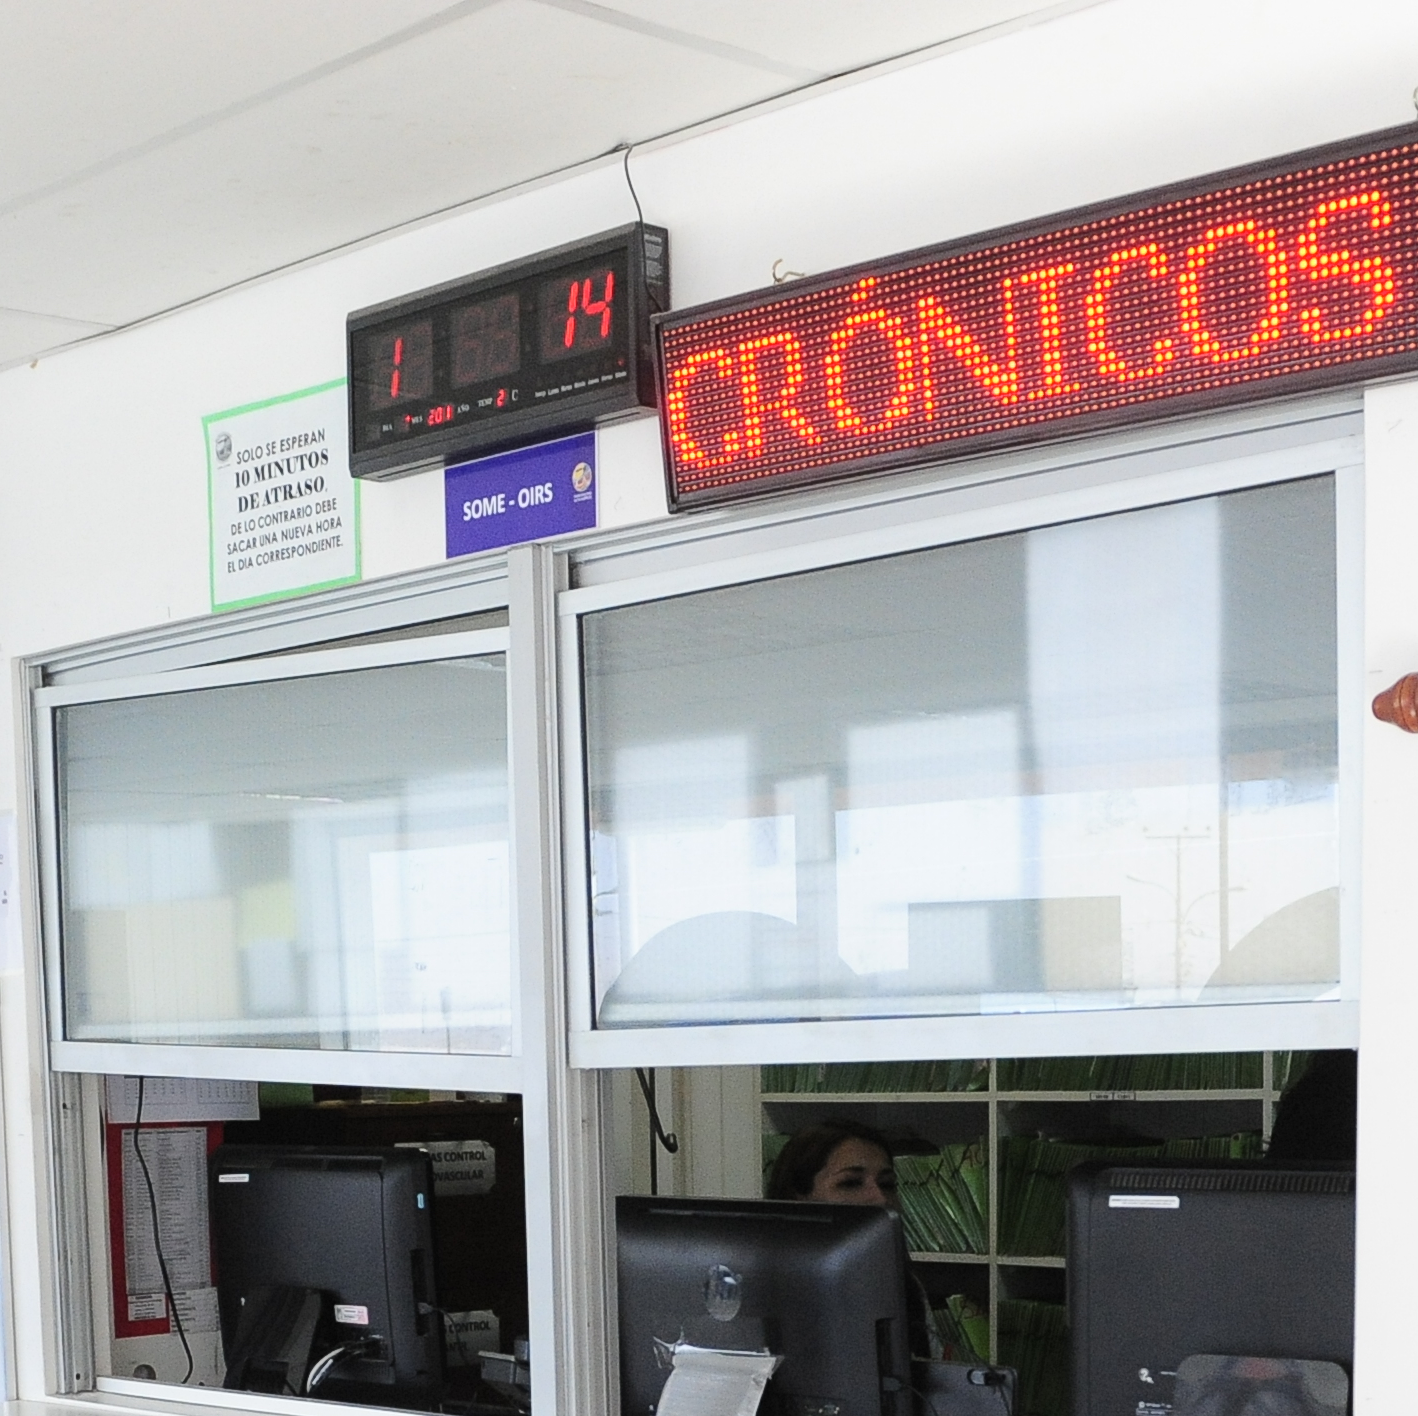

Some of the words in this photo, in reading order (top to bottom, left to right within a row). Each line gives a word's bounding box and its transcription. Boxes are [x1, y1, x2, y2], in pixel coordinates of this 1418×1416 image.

[564, 270, 615, 349] 14
[665, 189, 1396, 470] CRÓNICOS
[390, 337, 403, 399] 1
[237, 446, 263, 465] SOLO
[266, 442, 277, 455] SE
[280, 428, 325, 453] ESPERAN
[234, 471, 250, 488] 10
[253, 448, 329, 484] MINUTOS
[231, 522, 242, 536] DE
[244, 519, 256, 533] LO
[258, 504, 313, 529] CONTRARIO
[315, 498, 337, 515] DEBE
[238, 493, 259, 513] DE
[463, 493, 506, 521] SOME
[518, 482, 553, 509] OIRS
[227, 536, 257, 556] SACAR
[259, 532, 278, 548] UNA
[281, 525, 313, 543] NUEVA
[316, 516, 342, 533] HORA
[227, 561, 236, 574] EL
[238, 557, 253, 571] DIA
[256, 535, 343, 568] CORRESPONDIENTE.
[444, 1151, 487, 1162] CONTROL
